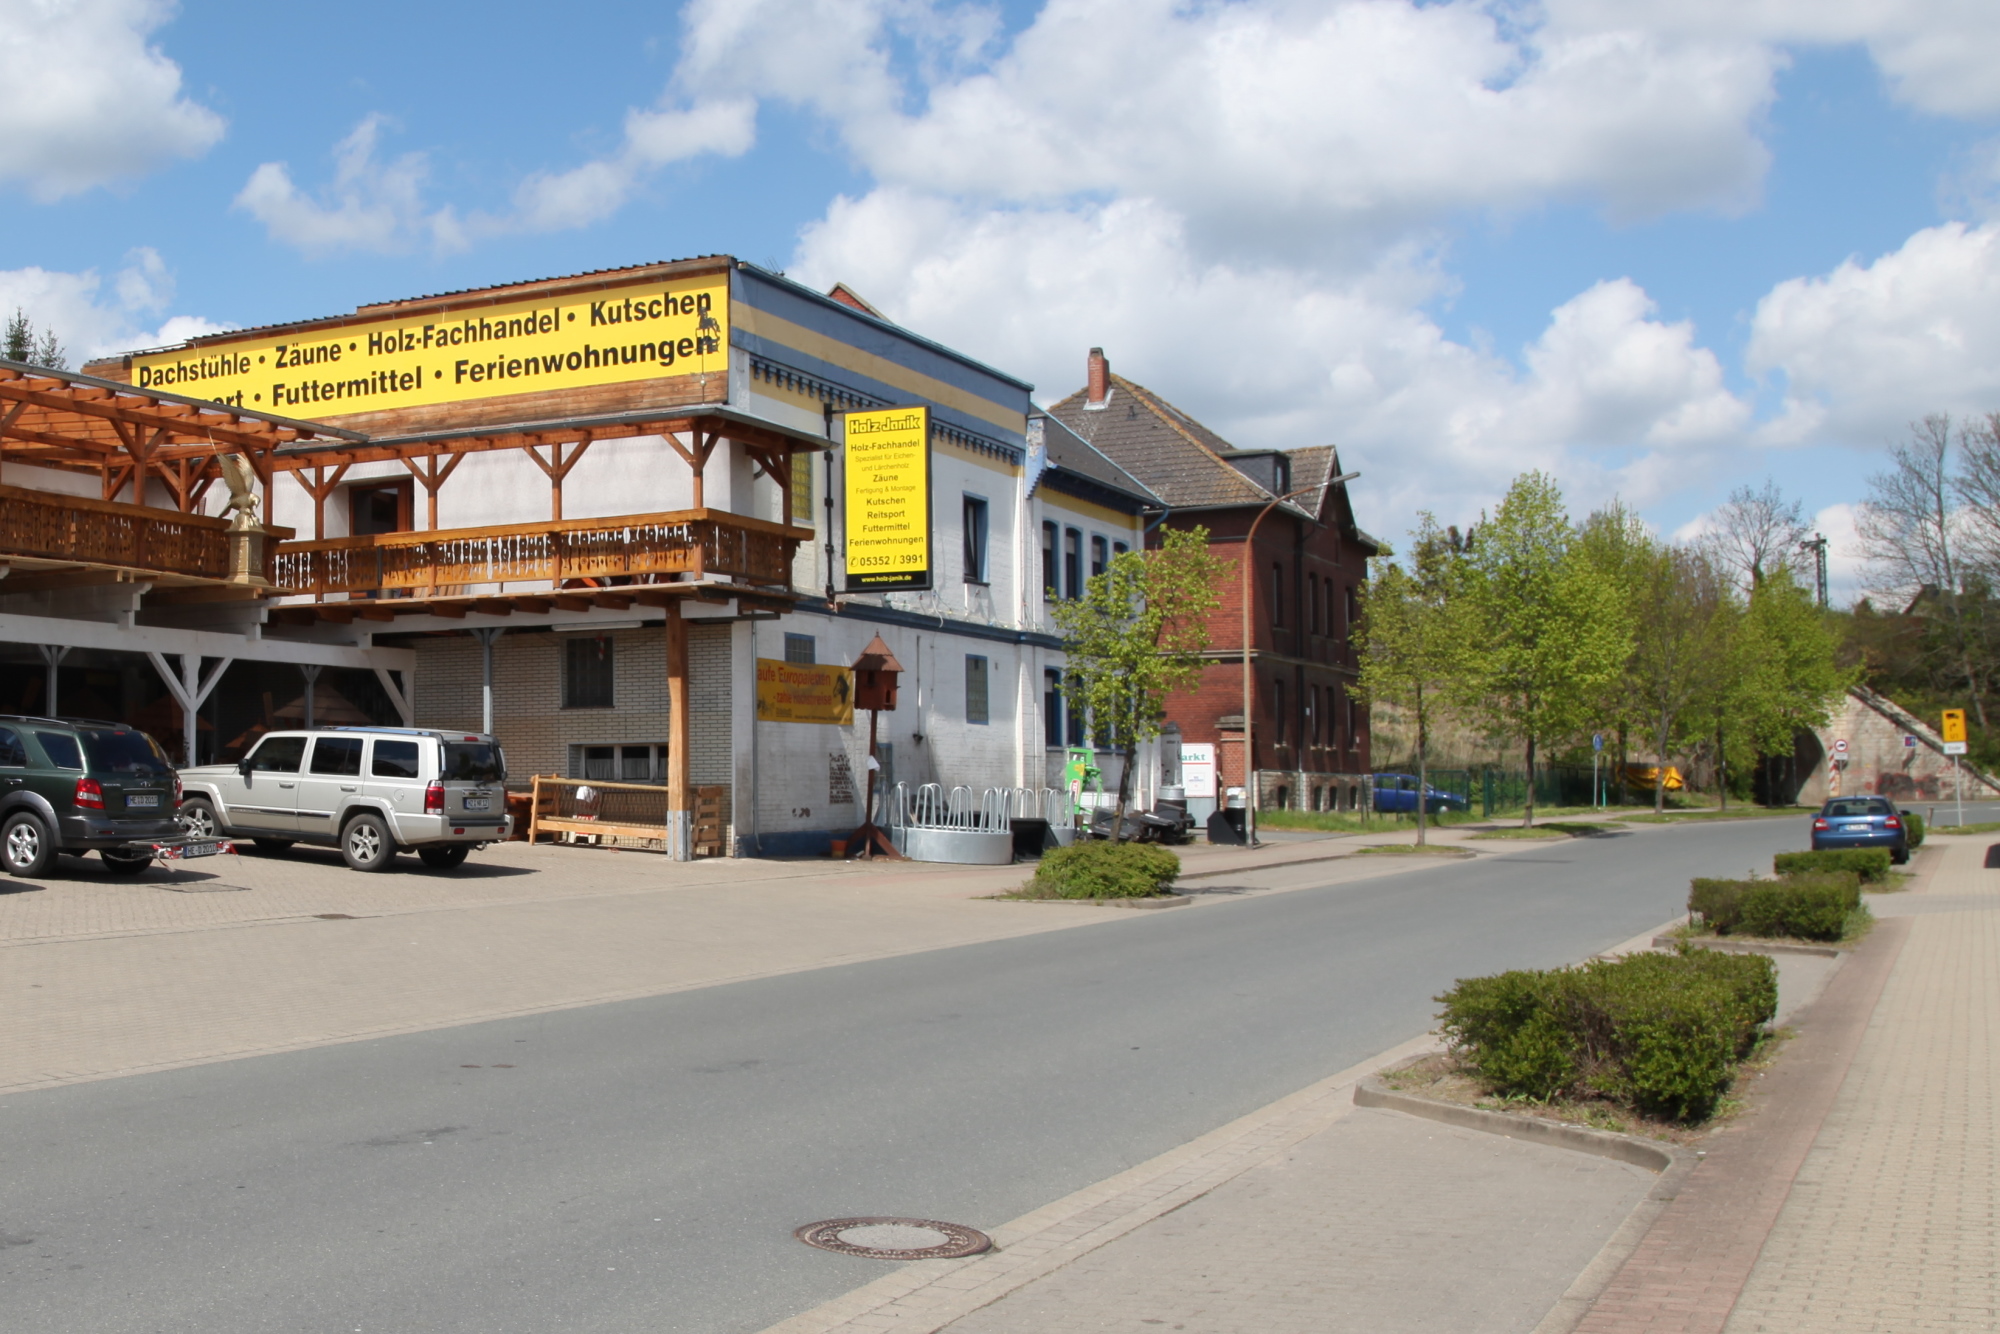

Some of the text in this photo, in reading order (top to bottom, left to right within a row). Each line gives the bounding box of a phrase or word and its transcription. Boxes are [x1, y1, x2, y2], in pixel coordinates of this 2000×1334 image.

[139, 291, 711, 387] Dachstühle Zäune Holz-Fachhandel Kutschen
[272, 365, 421, 407] Futtermittel
[455, 333, 712, 384] Ferienwohnungen
[850, 415, 920, 434] Holz Janik
[850, 439, 920, 452] Holz-Fachhandel
[855, 454, 883, 463] Spezialist
[874, 463, 909, 471] Lärchenholz
[873, 474, 898, 483] Zäune
[866, 497, 906, 506] Kutschen
[867, 510, 905, 520] Reitsport
[863, 522, 910, 533] Futtermittel
[849, 536, 924, 547] Ferienwohnungen
[860, 555, 890, 566] 05352
[900, 554, 923, 564] 3991
[861, 574, 912, 583] www.holz-janik.de
[757, 666, 776, 682] aufe
[1181, 753, 1205, 761] arkt
